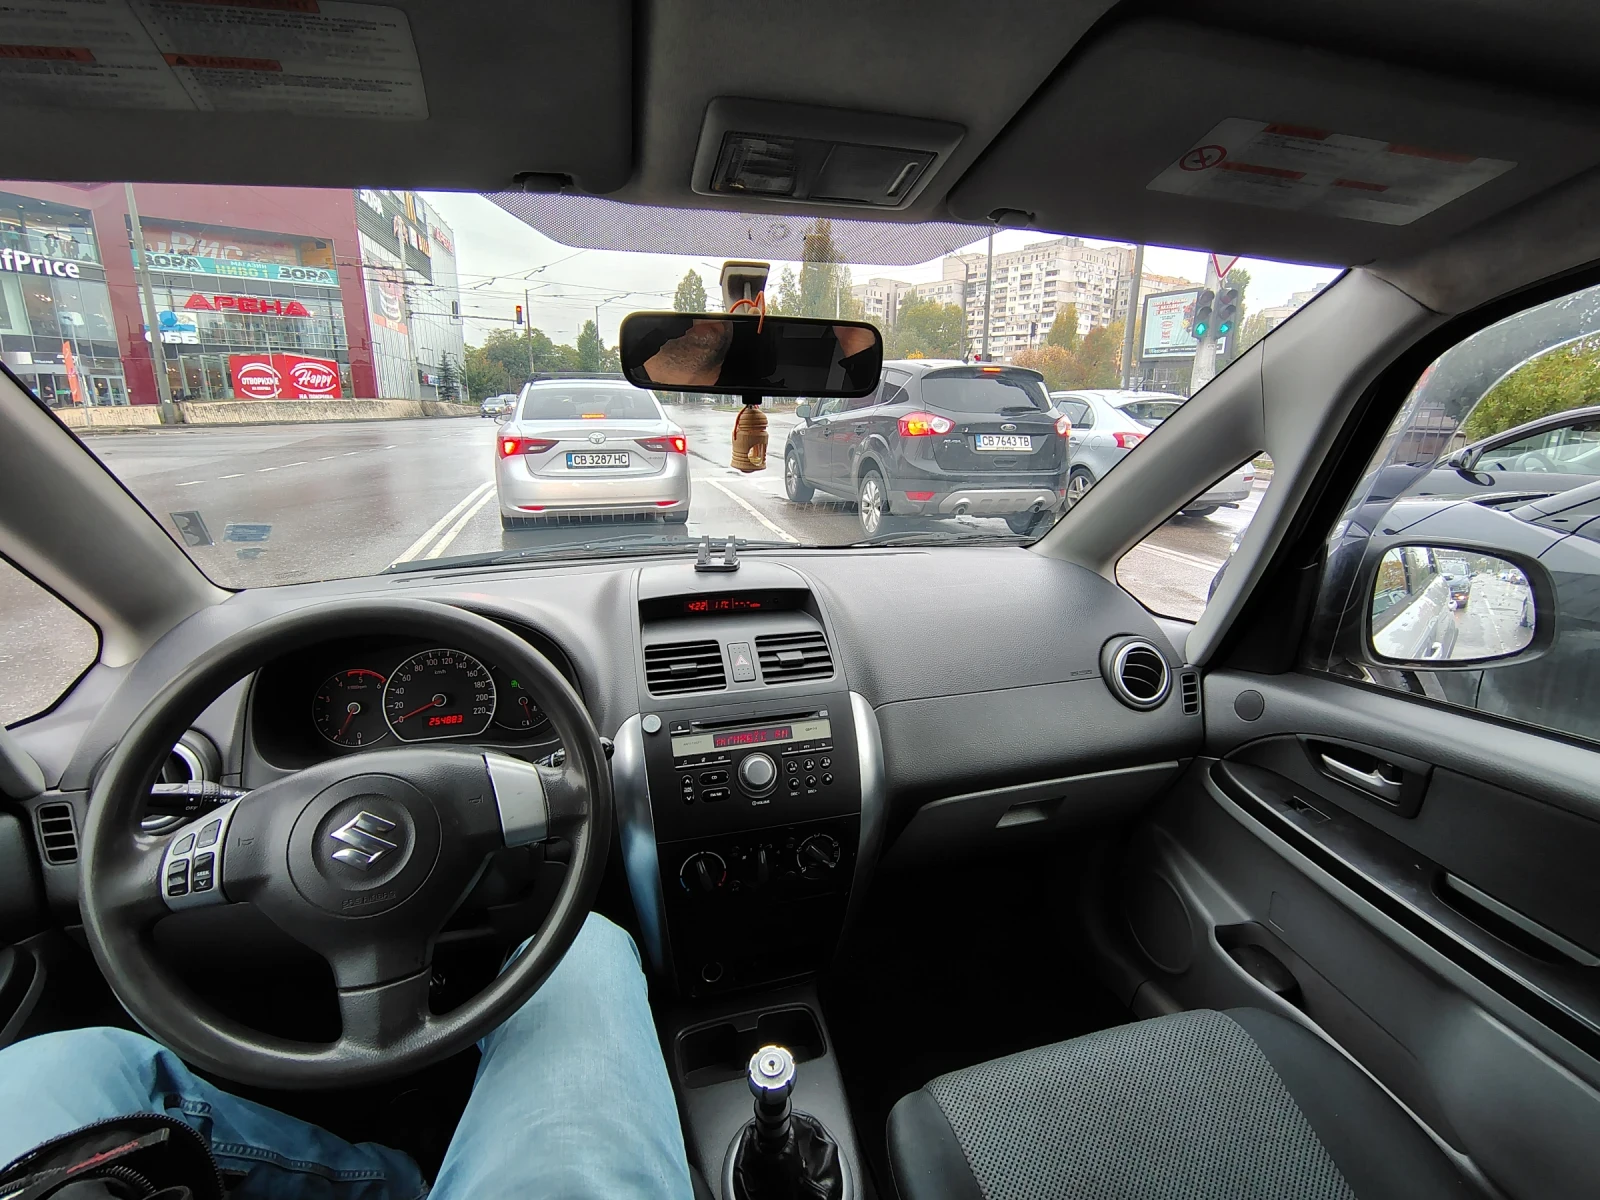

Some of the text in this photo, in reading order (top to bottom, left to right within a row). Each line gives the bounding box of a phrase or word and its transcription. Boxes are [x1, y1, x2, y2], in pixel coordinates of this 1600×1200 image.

[0, 247, 80, 279] fPrice
[215, 265, 258, 278] НИВО
[279, 266, 333, 284] ЗОРА
[184, 294, 310, 317] АРЕНА
[295, 369, 333, 388] Happy
[982, 435, 1030, 447] CB 7643 TB
[573, 453, 627, 465] CB 3287 HC
[426, 658, 438, 666] 100
[441, 657, 453, 665] 120
[455, 661, 467, 669] 140
[414, 664, 424, 672] 80
[401, 674, 411, 682] 60
[466, 669, 478, 678] 160
[474, 680, 485, 689] 180
[395, 687, 405, 695] 40
[475, 694, 488, 702] 200
[394, 701, 404, 709] 20
[428, 714, 463, 727] 254883
